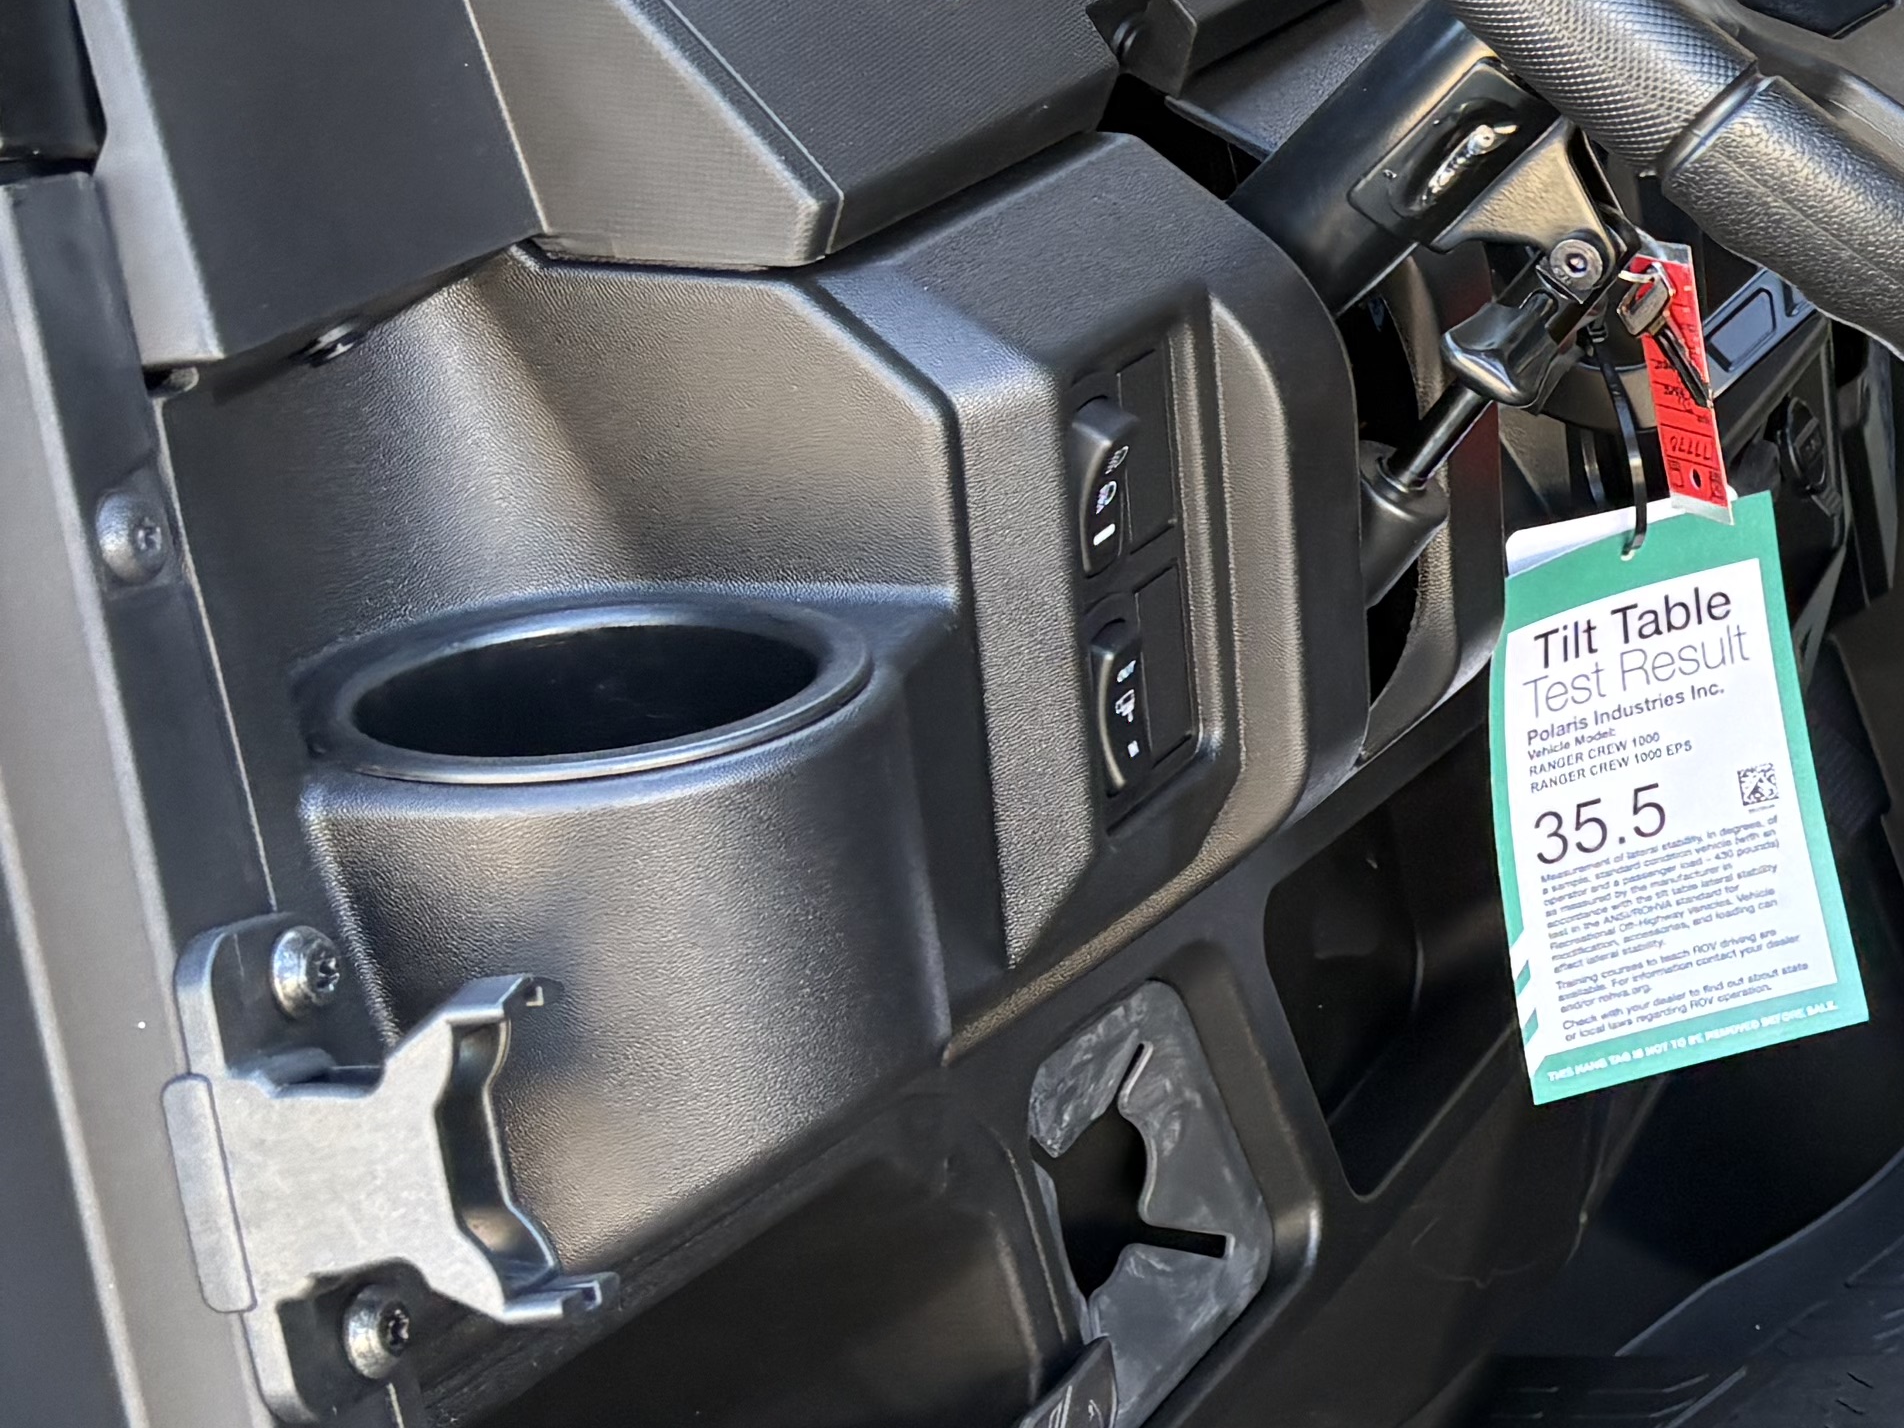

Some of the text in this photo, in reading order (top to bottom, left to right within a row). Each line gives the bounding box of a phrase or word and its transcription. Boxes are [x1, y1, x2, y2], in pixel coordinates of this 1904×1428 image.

[1534, 587, 1731, 669] Tilt Table
[1523, 624, 1749, 718] Test Result
[1527, 682, 1724, 745] Polaris Industries Inc.
[1528, 741, 1570, 760] Vehicle
[1530, 732, 1660, 776] RANGER CREW 1000
[1531, 740, 1693, 793] RANGER CREW 1000 EPS
[1534, 782, 1665, 864] 35.5
